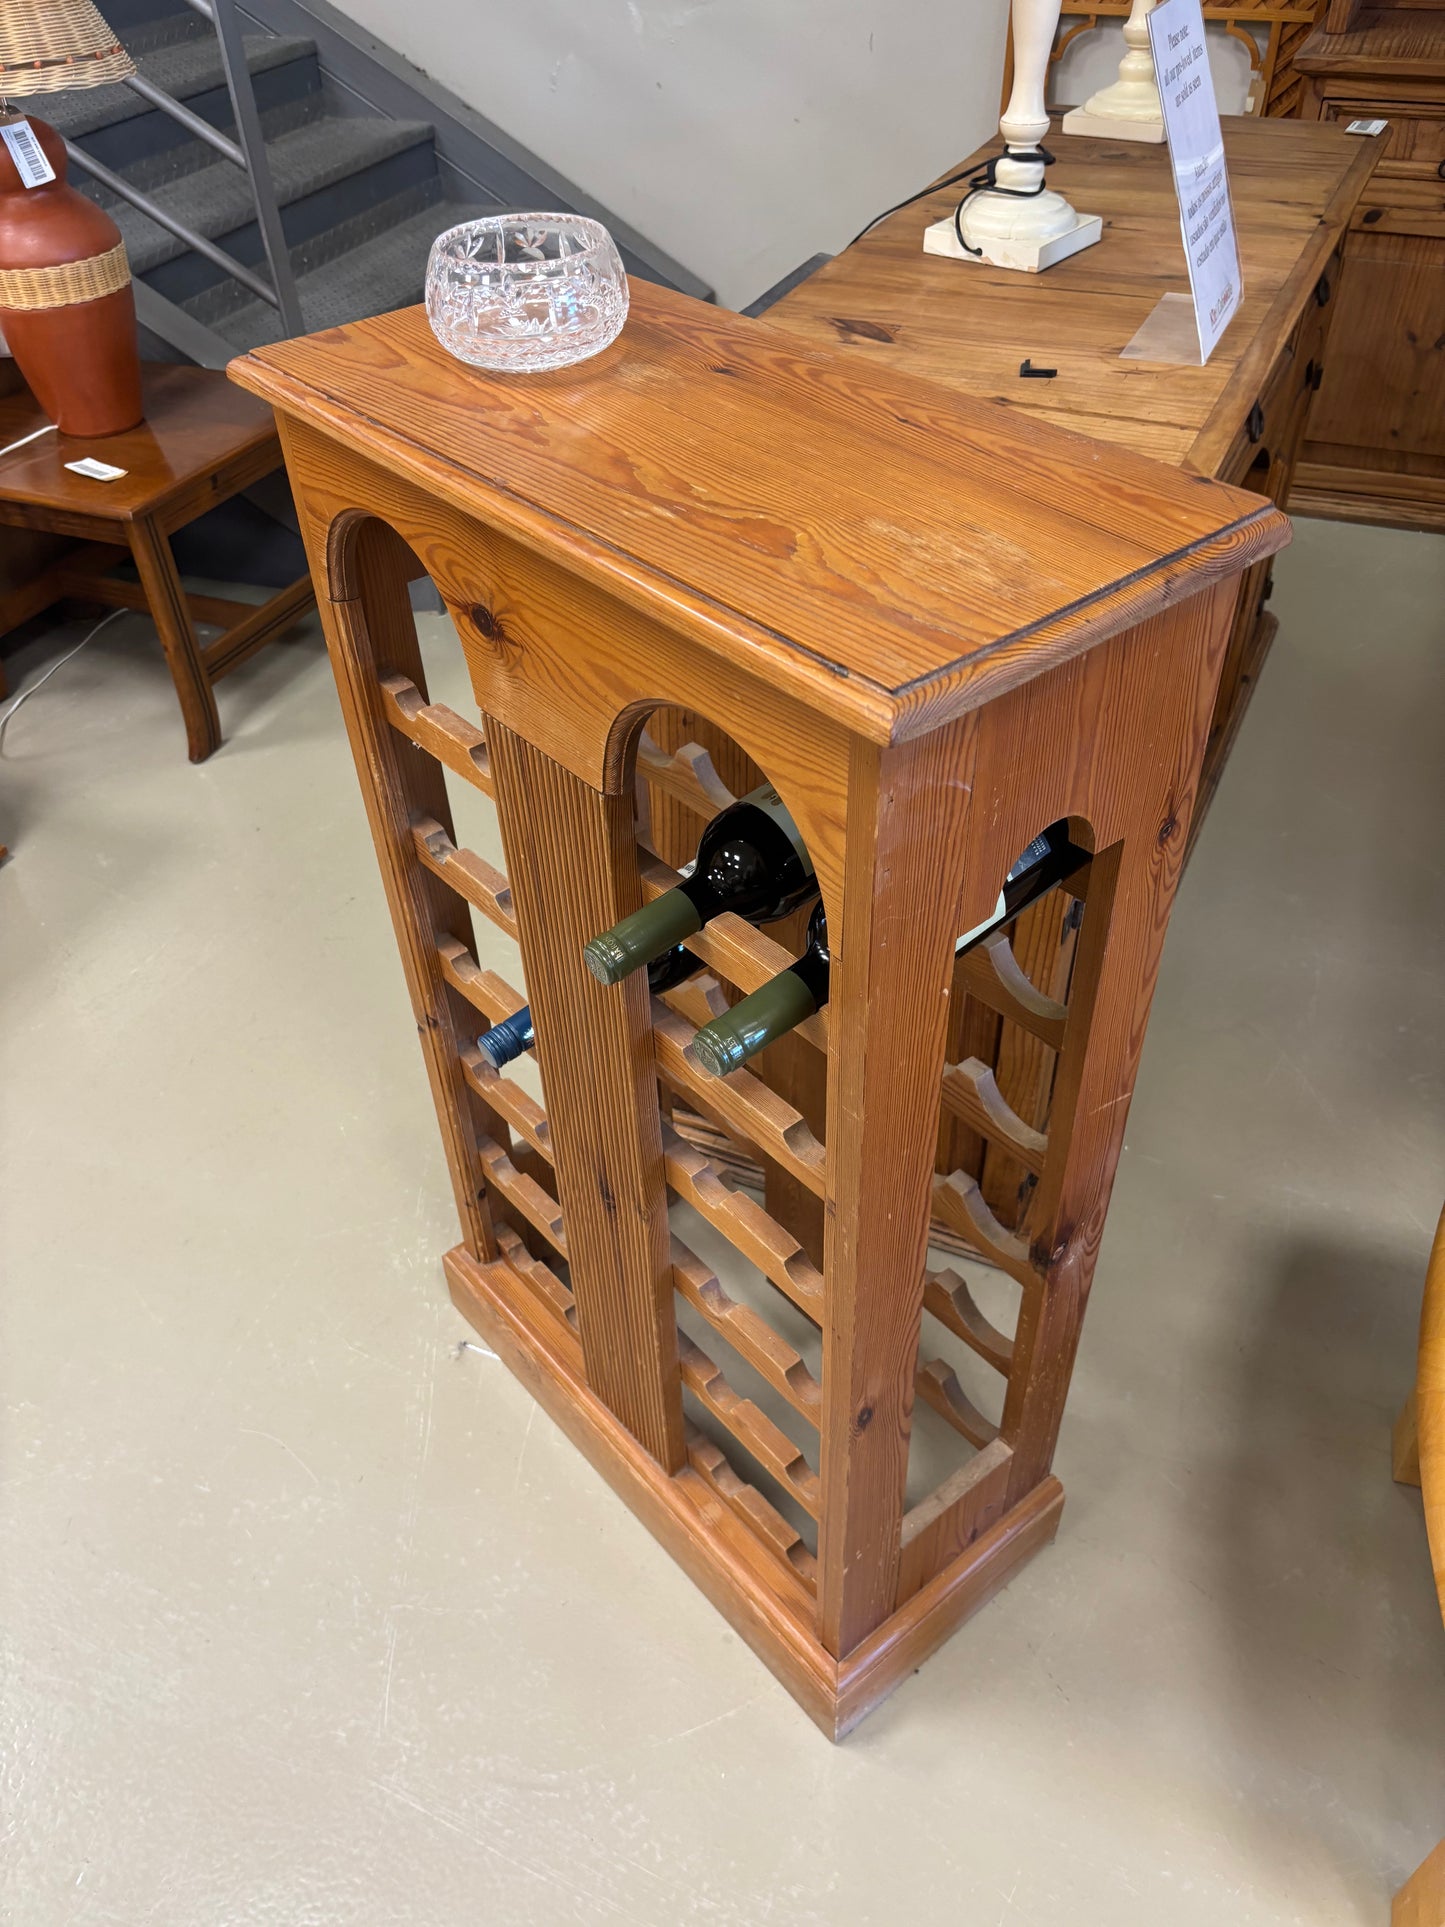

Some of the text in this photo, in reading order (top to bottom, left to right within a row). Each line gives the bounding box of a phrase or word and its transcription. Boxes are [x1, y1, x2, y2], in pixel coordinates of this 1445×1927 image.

[1168, 33, 1180, 51] Please
[1175, 48, 1192, 80] pre-loved
[1191, 44, 1203, 61] items
[1180, 81, 1189, 102] sold
[1192, 75, 1202, 91] seen
